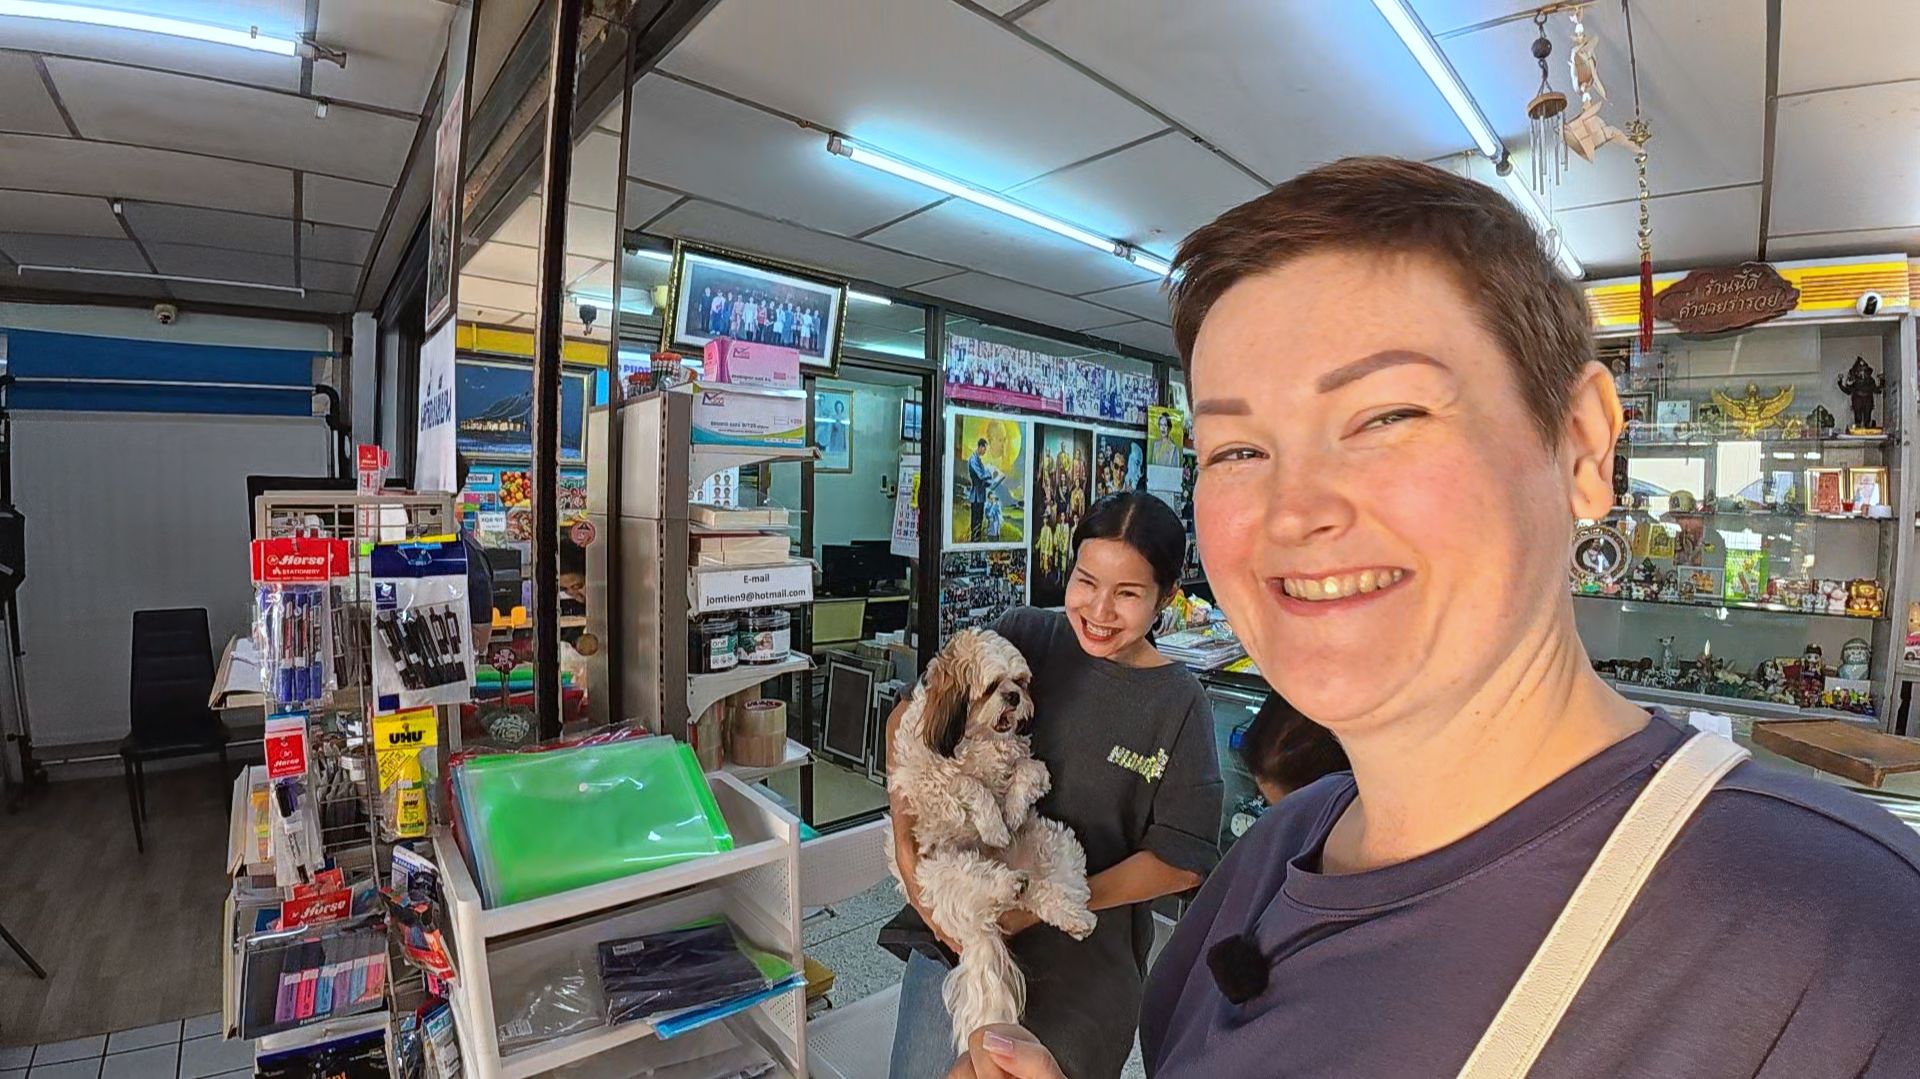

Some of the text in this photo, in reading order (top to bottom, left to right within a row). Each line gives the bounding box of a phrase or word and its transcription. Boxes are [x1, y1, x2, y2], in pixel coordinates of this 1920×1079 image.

[1703, 268, 1762, 296] ร้านนี้ดี
[1679, 289, 1780, 319] ค้าขายร่ำรวย
[278, 555, 325, 566] Horse
[743, 573, 770, 584] E-mail
[706, 588, 806, 606] jomtien9@hotmail.com
[389, 731, 423, 744] UHU
[300, 899, 347, 919] Horse
